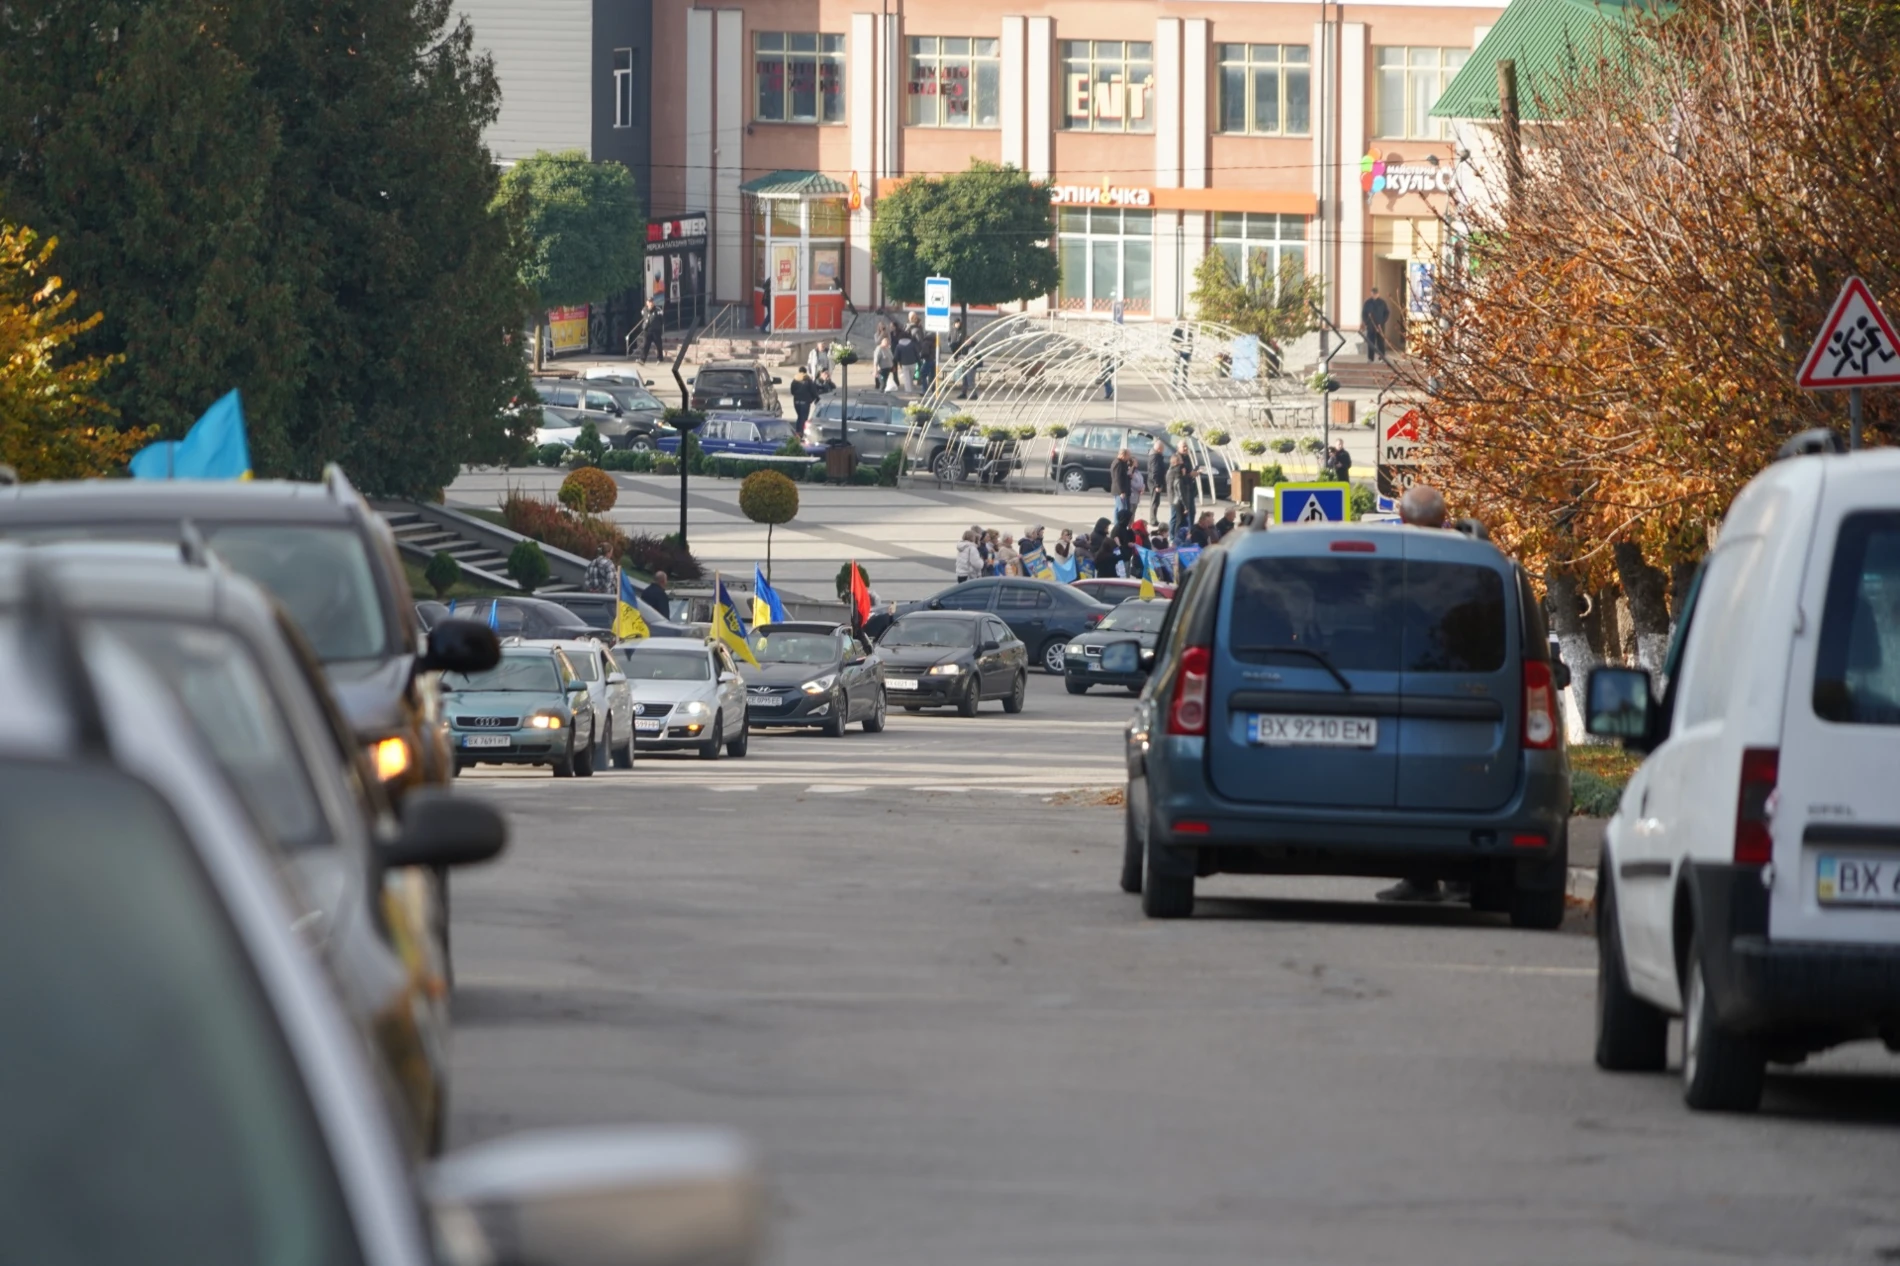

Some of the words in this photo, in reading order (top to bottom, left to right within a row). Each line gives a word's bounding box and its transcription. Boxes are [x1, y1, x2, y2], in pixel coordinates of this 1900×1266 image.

[1261, 718, 1288, 737] BX
[1294, 719, 1338, 739] 9210
[1343, 721, 1371, 740] EM
